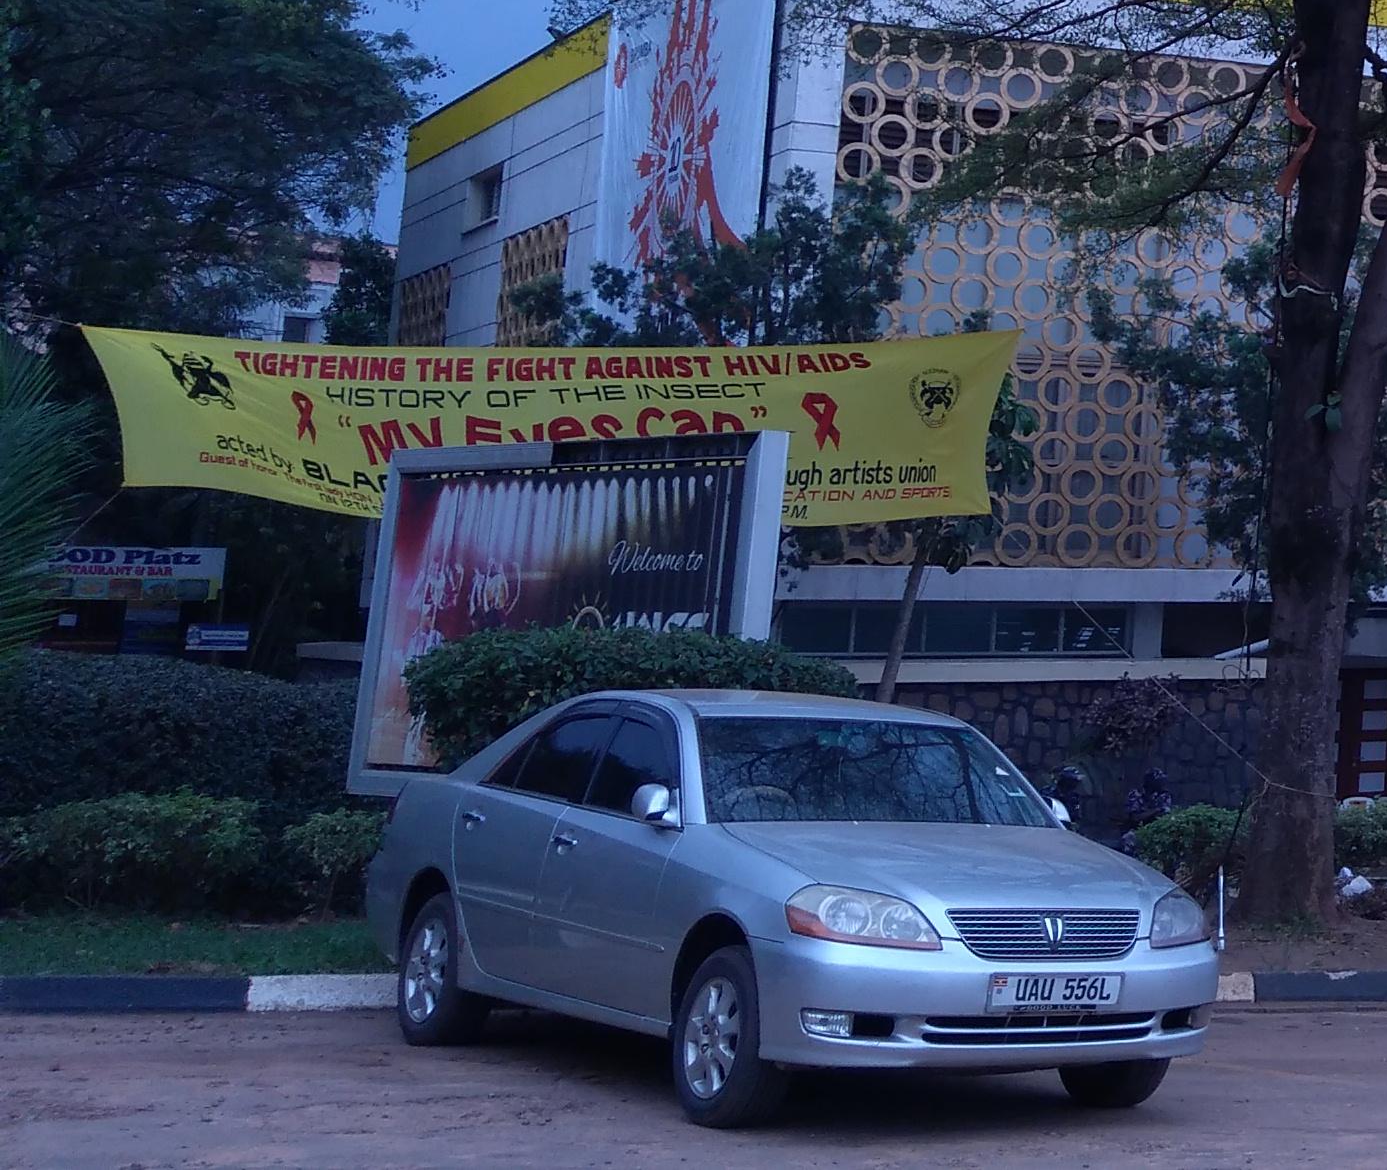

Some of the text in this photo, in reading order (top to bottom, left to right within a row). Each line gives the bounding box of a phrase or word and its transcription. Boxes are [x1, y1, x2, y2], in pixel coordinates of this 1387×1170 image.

[234, 351, 872, 382] TIGHTENING THE FIGHT AGAINST HIV/AIDS
[326, 382, 767, 409] HISTORY OF THE INSECT
[199, 451, 237, 466] Guest
[216, 434, 266, 463] acted
[786, 458, 937, 491] ugh artists union
[783, 490, 854, 503] CATION
[861, 488, 897, 501] AND
[122, 550, 202, 566] Platz
[607, 540, 704, 576] Welcome to
[147, 565, 173, 577] BAR
[1015, 977, 1111, 1001] UAU 556L
